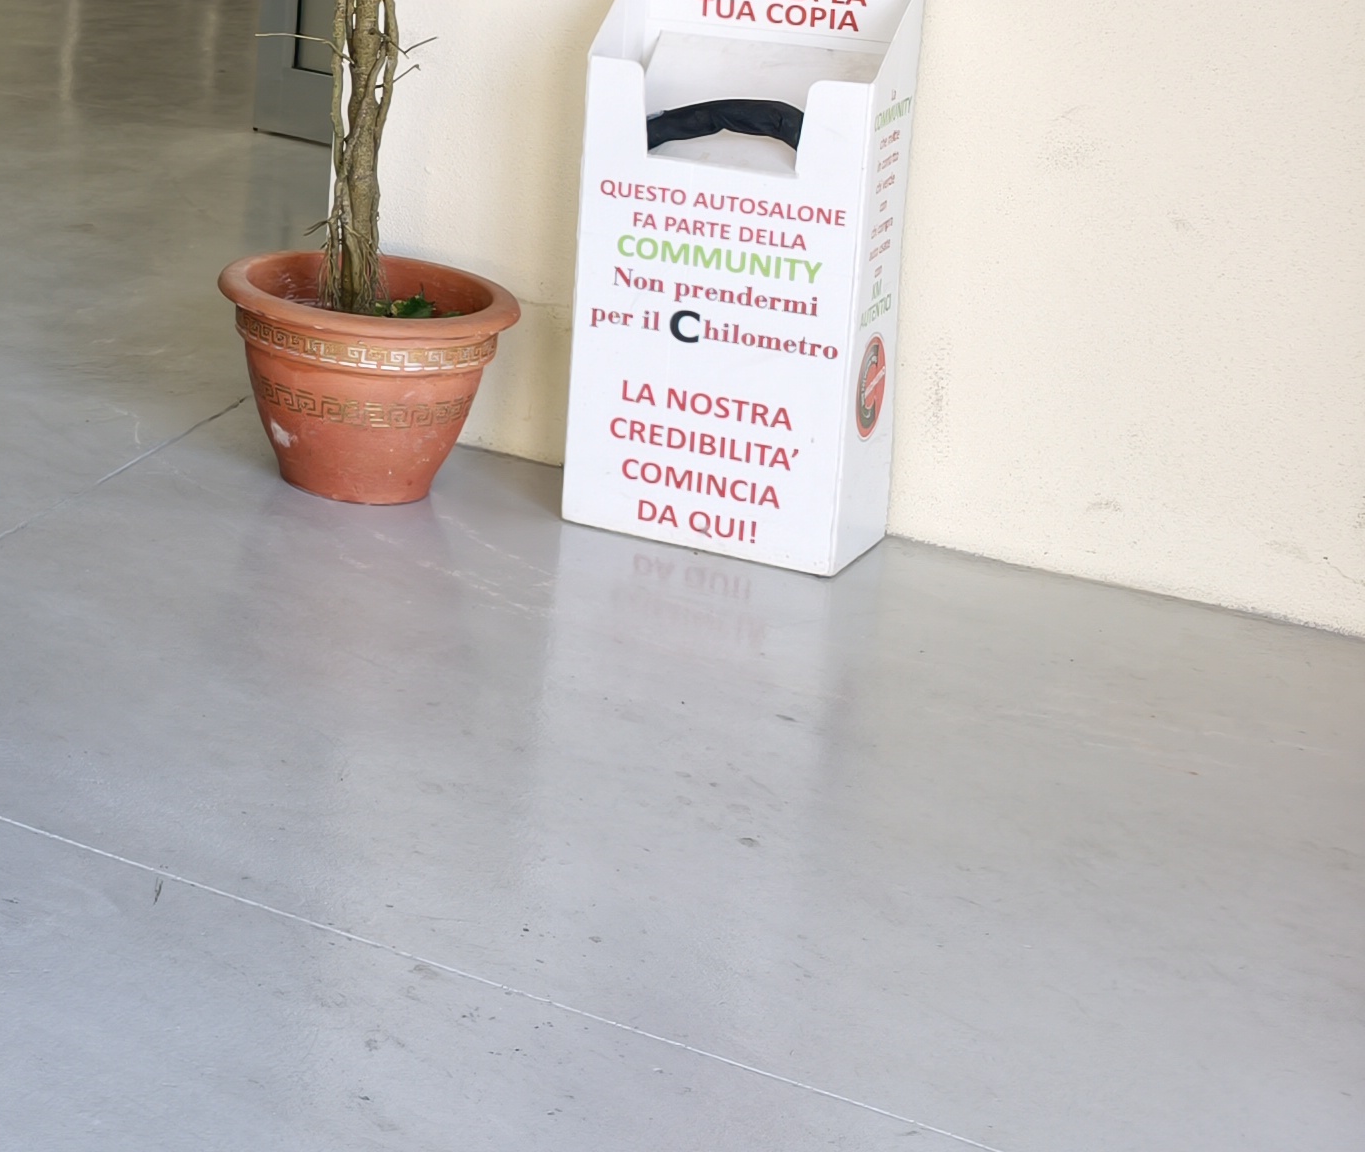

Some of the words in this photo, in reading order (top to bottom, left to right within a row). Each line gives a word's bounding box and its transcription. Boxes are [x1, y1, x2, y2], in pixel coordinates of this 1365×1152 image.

[766, 3, 859, 32] COPIA
[600, 179, 687, 205] QUESTO
[693, 192, 847, 227] AUTOSALONE
[632, 211, 657, 231] FA
[664, 216, 731, 240] PARTE
[738, 226, 807, 251] DELLA
[616, 234, 823, 284] COMMUNITY
[613, 266, 665, 294] Non
[674, 281, 819, 317] prendermi
[590, 306, 634, 328] per
[641, 310, 660, 331] il
[669, 309, 839, 360] Chilometro
[621, 379, 656, 406] LA
[666, 387, 793, 431] NOSTRA
[610, 417, 799, 471] CREDIBILITA'
[621, 458, 781, 509] COMINCIA
[637, 499, 679, 528] DA
[688, 510, 757, 544] QUI!
